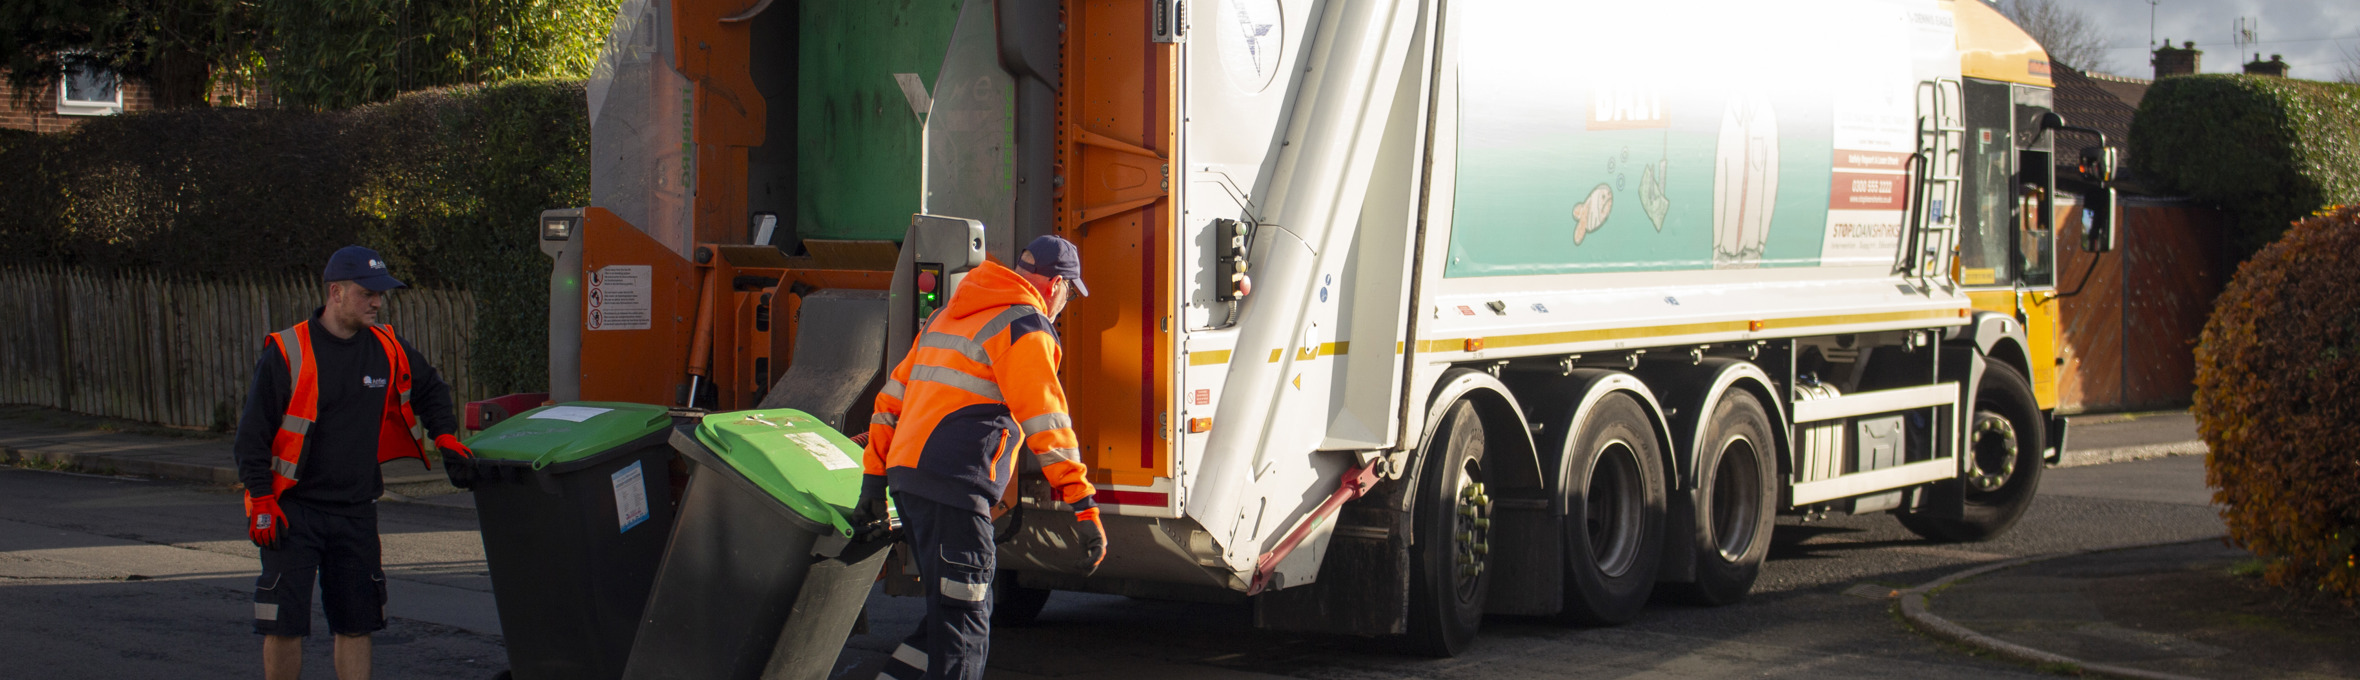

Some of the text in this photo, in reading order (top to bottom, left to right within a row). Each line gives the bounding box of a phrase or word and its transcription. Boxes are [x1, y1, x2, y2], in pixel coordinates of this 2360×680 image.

[1004, 84, 1013, 191] TERBERG
[1852, 180, 1892, 193] 0300 555 2222
